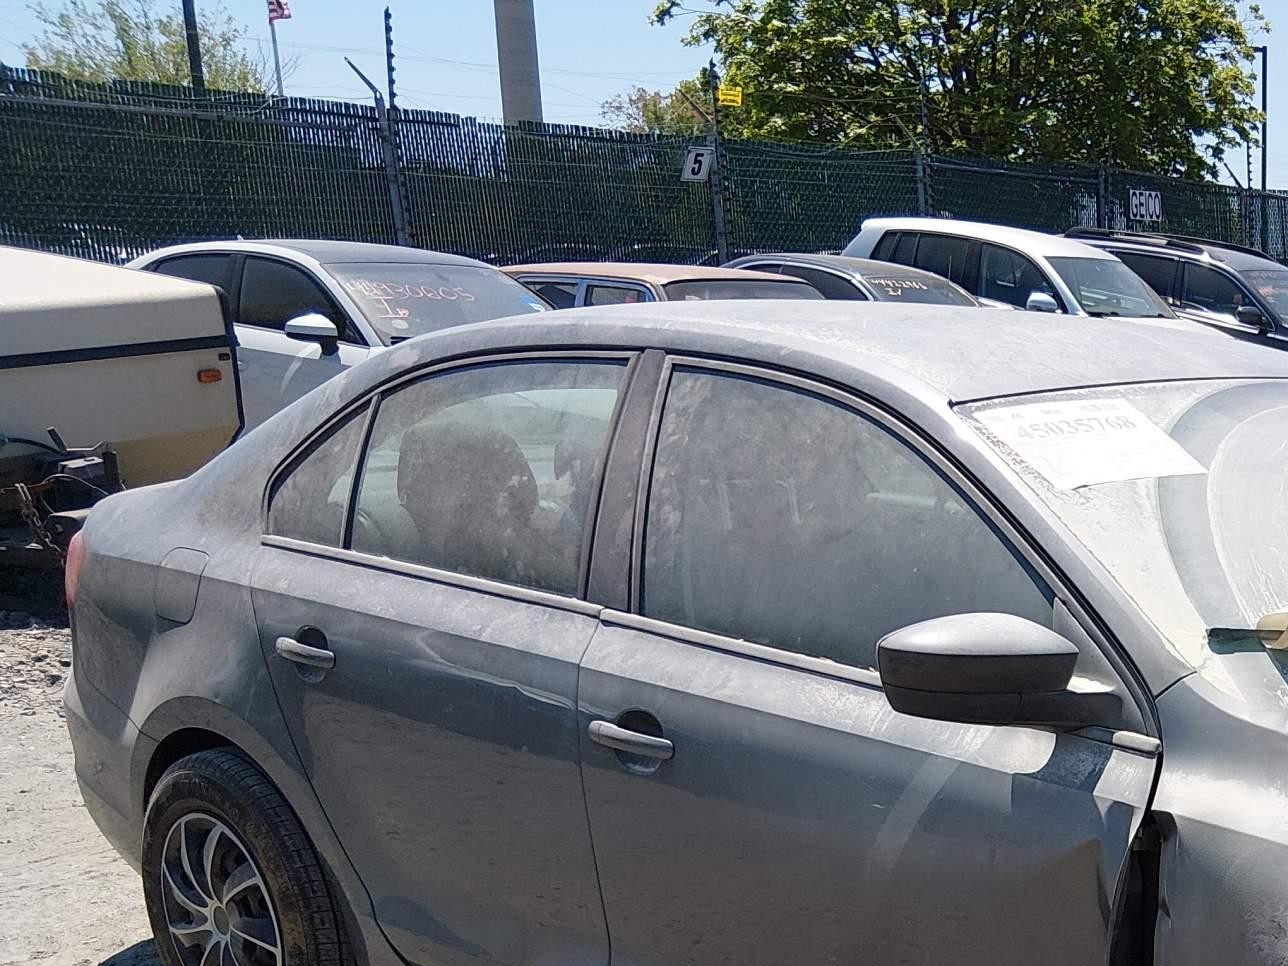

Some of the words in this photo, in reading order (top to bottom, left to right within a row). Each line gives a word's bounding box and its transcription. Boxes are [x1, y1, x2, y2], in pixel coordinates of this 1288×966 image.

[690, 152, 705, 177] 5
[1131, 190, 1161, 220] GEICO
[1017, 414, 1138, 440] 45035768
